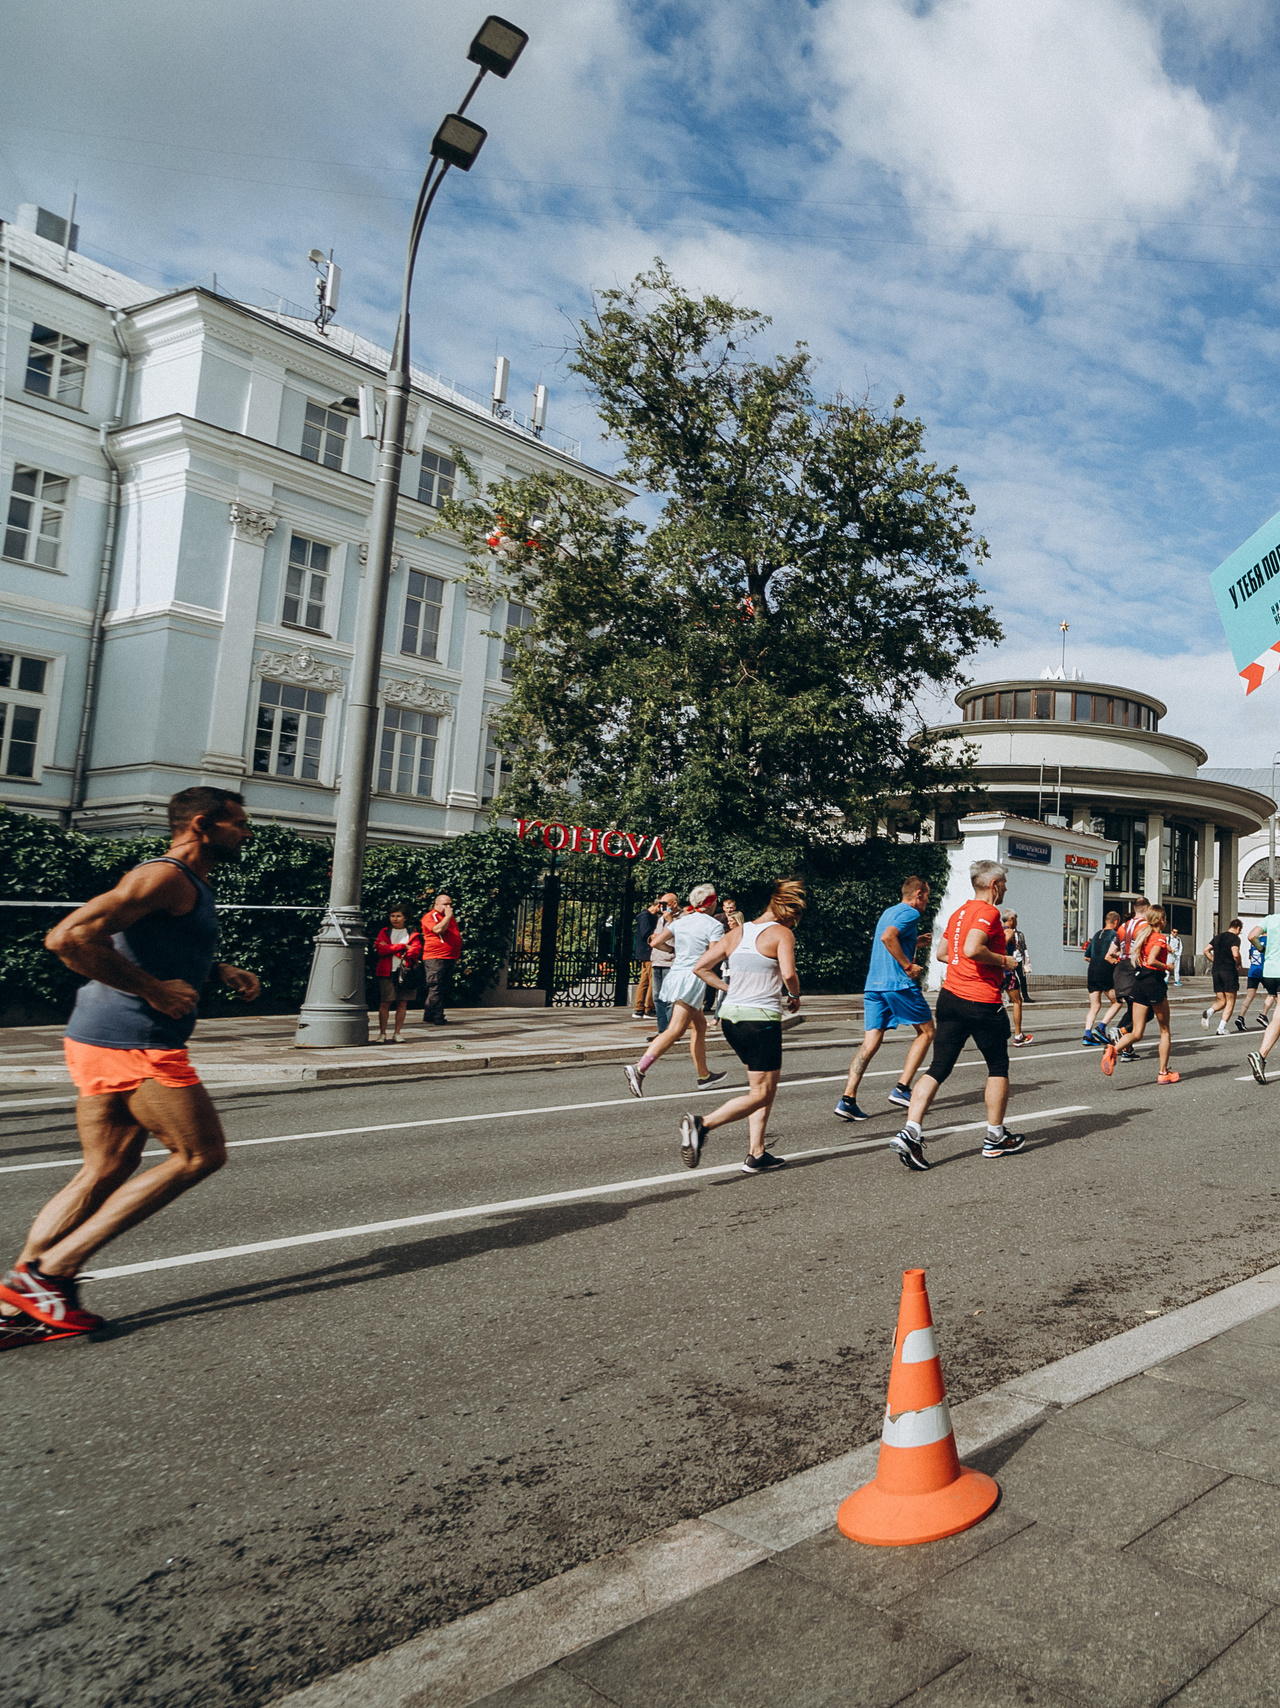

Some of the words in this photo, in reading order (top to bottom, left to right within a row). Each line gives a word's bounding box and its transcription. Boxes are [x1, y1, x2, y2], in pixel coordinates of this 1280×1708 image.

[1228, 585, 1238, 609] У
[1236, 563, 1265, 602] ТЕБЯ
[513, 817, 665, 862] КОНСУЛ
